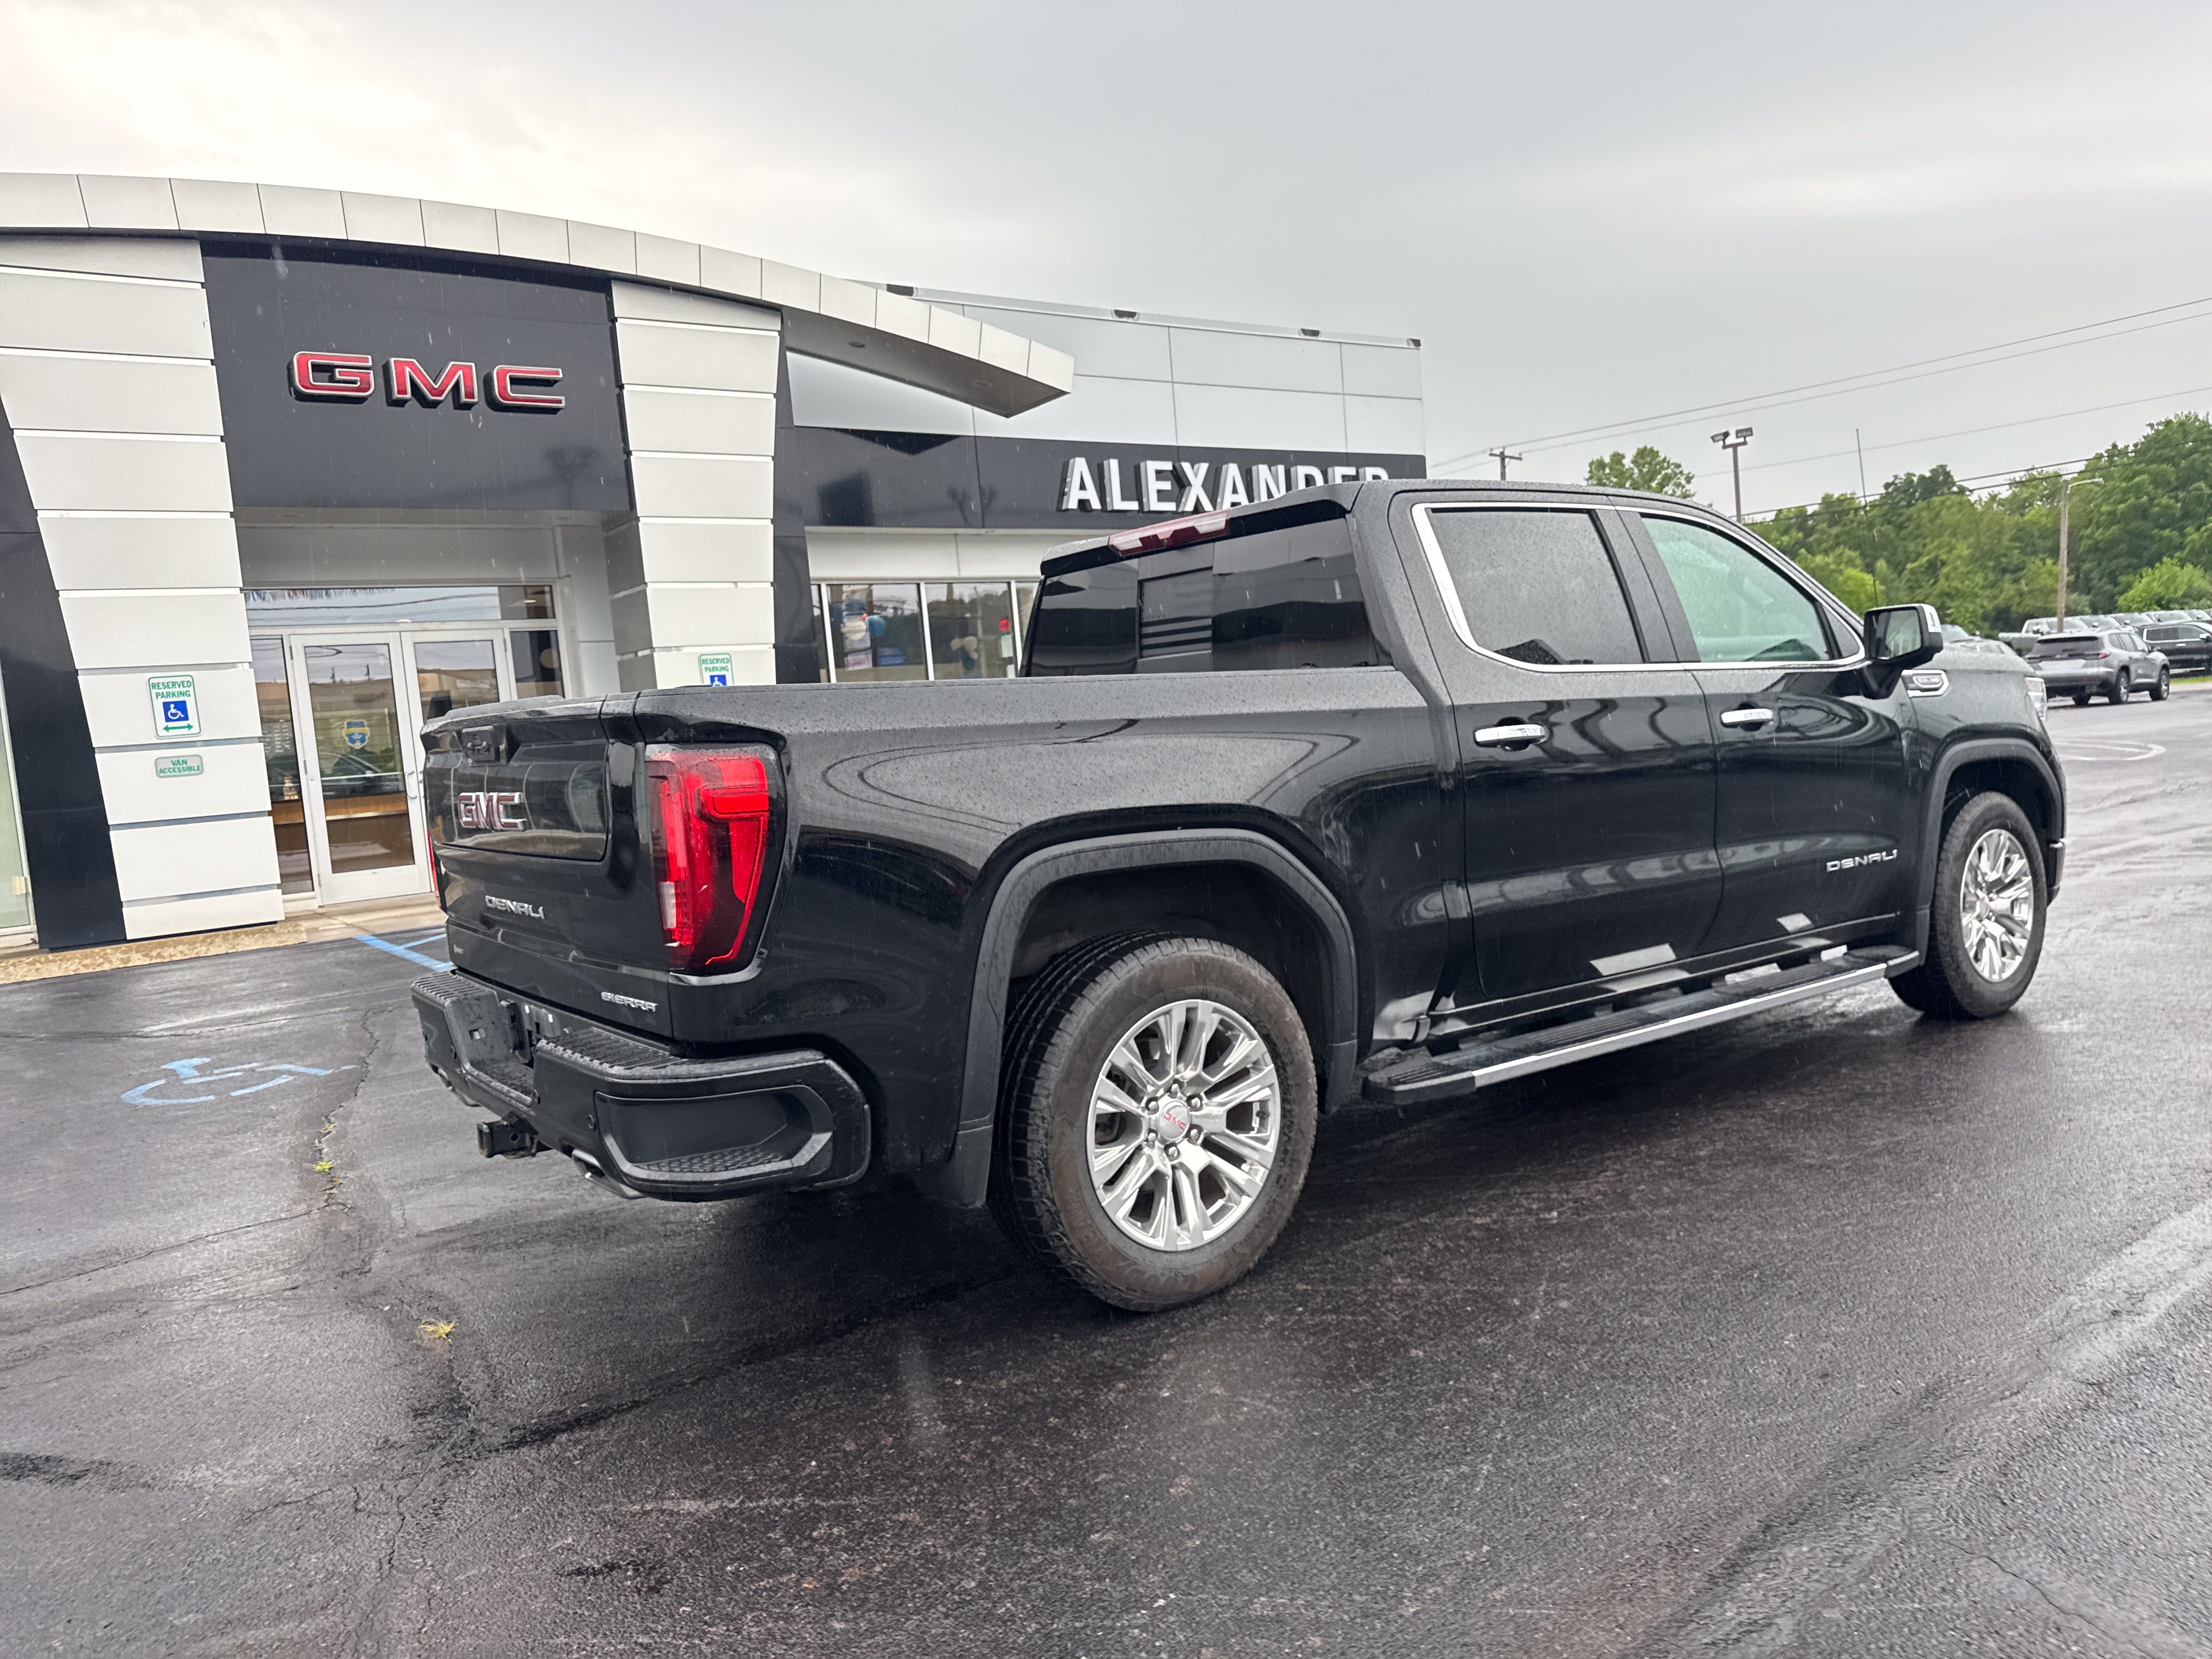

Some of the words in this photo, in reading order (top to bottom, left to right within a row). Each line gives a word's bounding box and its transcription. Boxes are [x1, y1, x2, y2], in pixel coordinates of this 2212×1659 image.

[293, 351, 565, 408] GMC
[1065, 457, 1389, 512] ALEXAND
[151, 680, 191, 690] RESERVED
[155, 690, 191, 699] PARKING
[159, 765, 202, 774] ACCESSIBLE
[458, 792, 527, 831] GMC
[1826, 849, 1898, 872] DENALI
[485, 895, 545, 919] DENALI
[601, 992, 658, 1012] SIERRA
[1164, 1111, 1186, 1131] GMC
